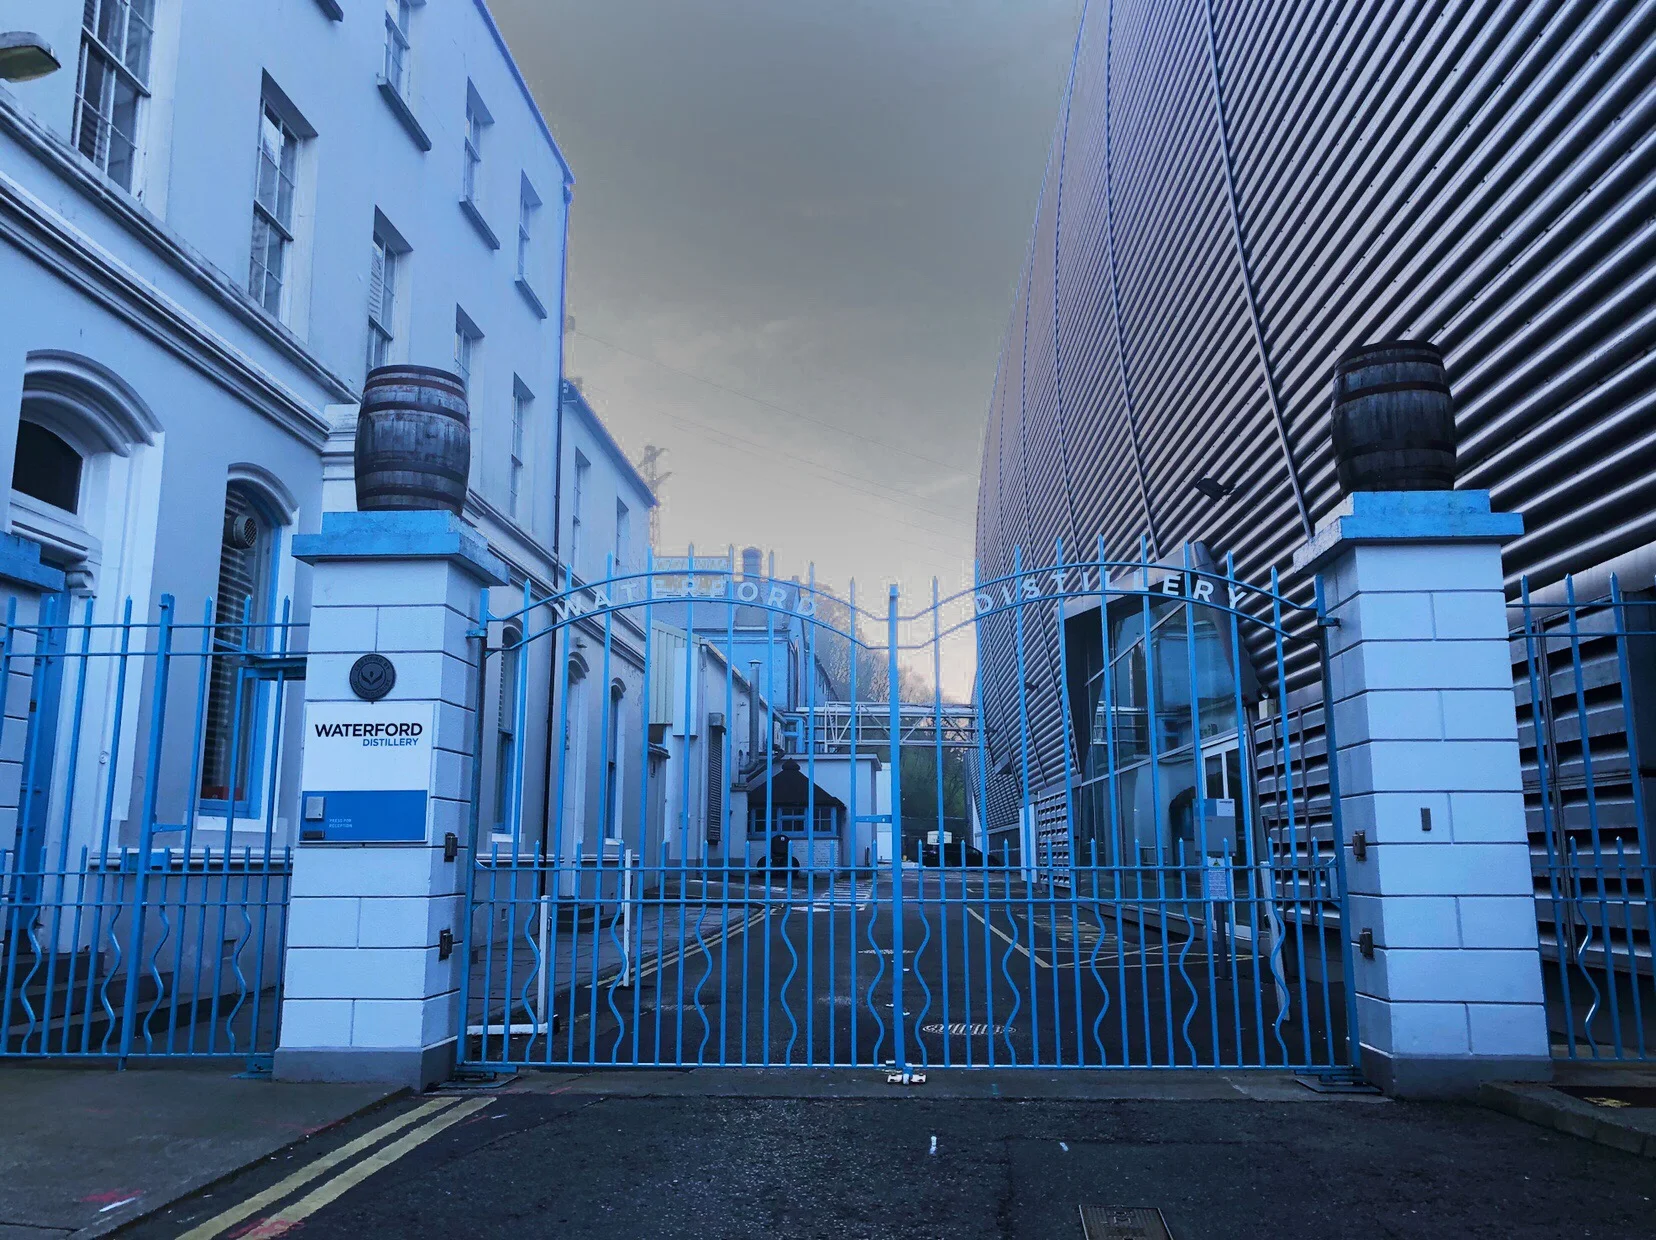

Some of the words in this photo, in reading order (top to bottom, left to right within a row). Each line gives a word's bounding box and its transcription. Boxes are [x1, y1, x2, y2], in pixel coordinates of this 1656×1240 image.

[554, 580, 817, 620] WATERFORD
[975, 567, 1248, 615] DISTILLERY
[314, 722, 423, 738] WATERFORD
[362, 737, 419, 747] DISTILLERY
